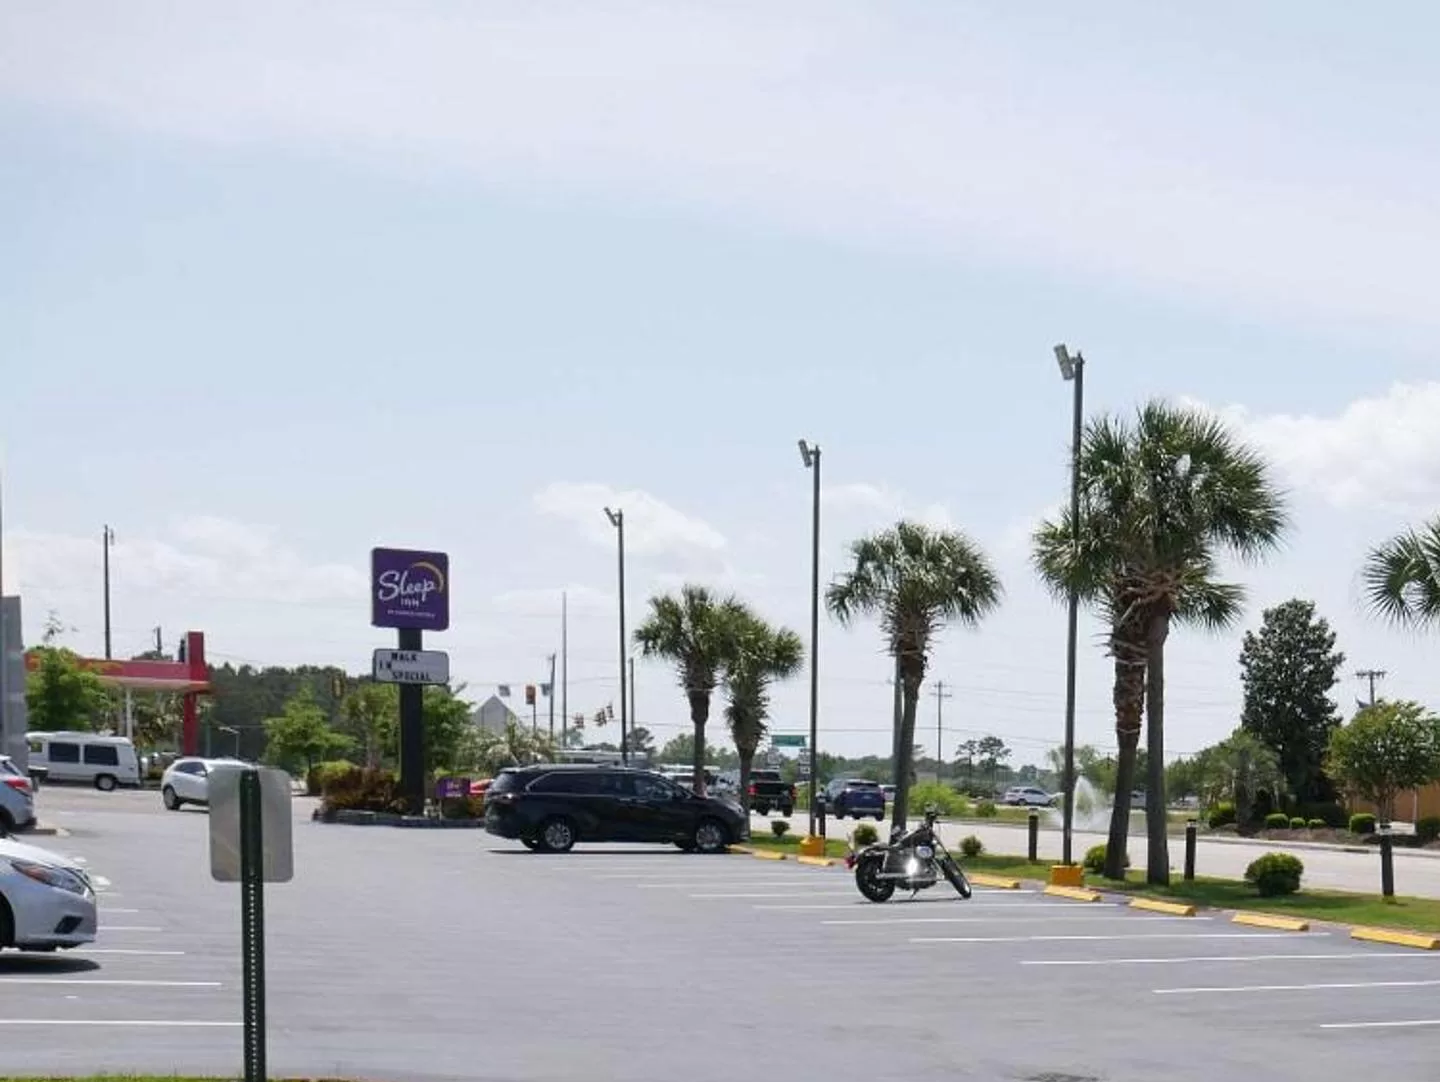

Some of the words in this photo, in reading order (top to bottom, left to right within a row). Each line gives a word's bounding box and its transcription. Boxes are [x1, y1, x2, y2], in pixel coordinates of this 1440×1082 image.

[378, 569, 436, 602] Sleep
[391, 652, 418, 662] WALK
[392, 671, 432, 681] SPECIAL
